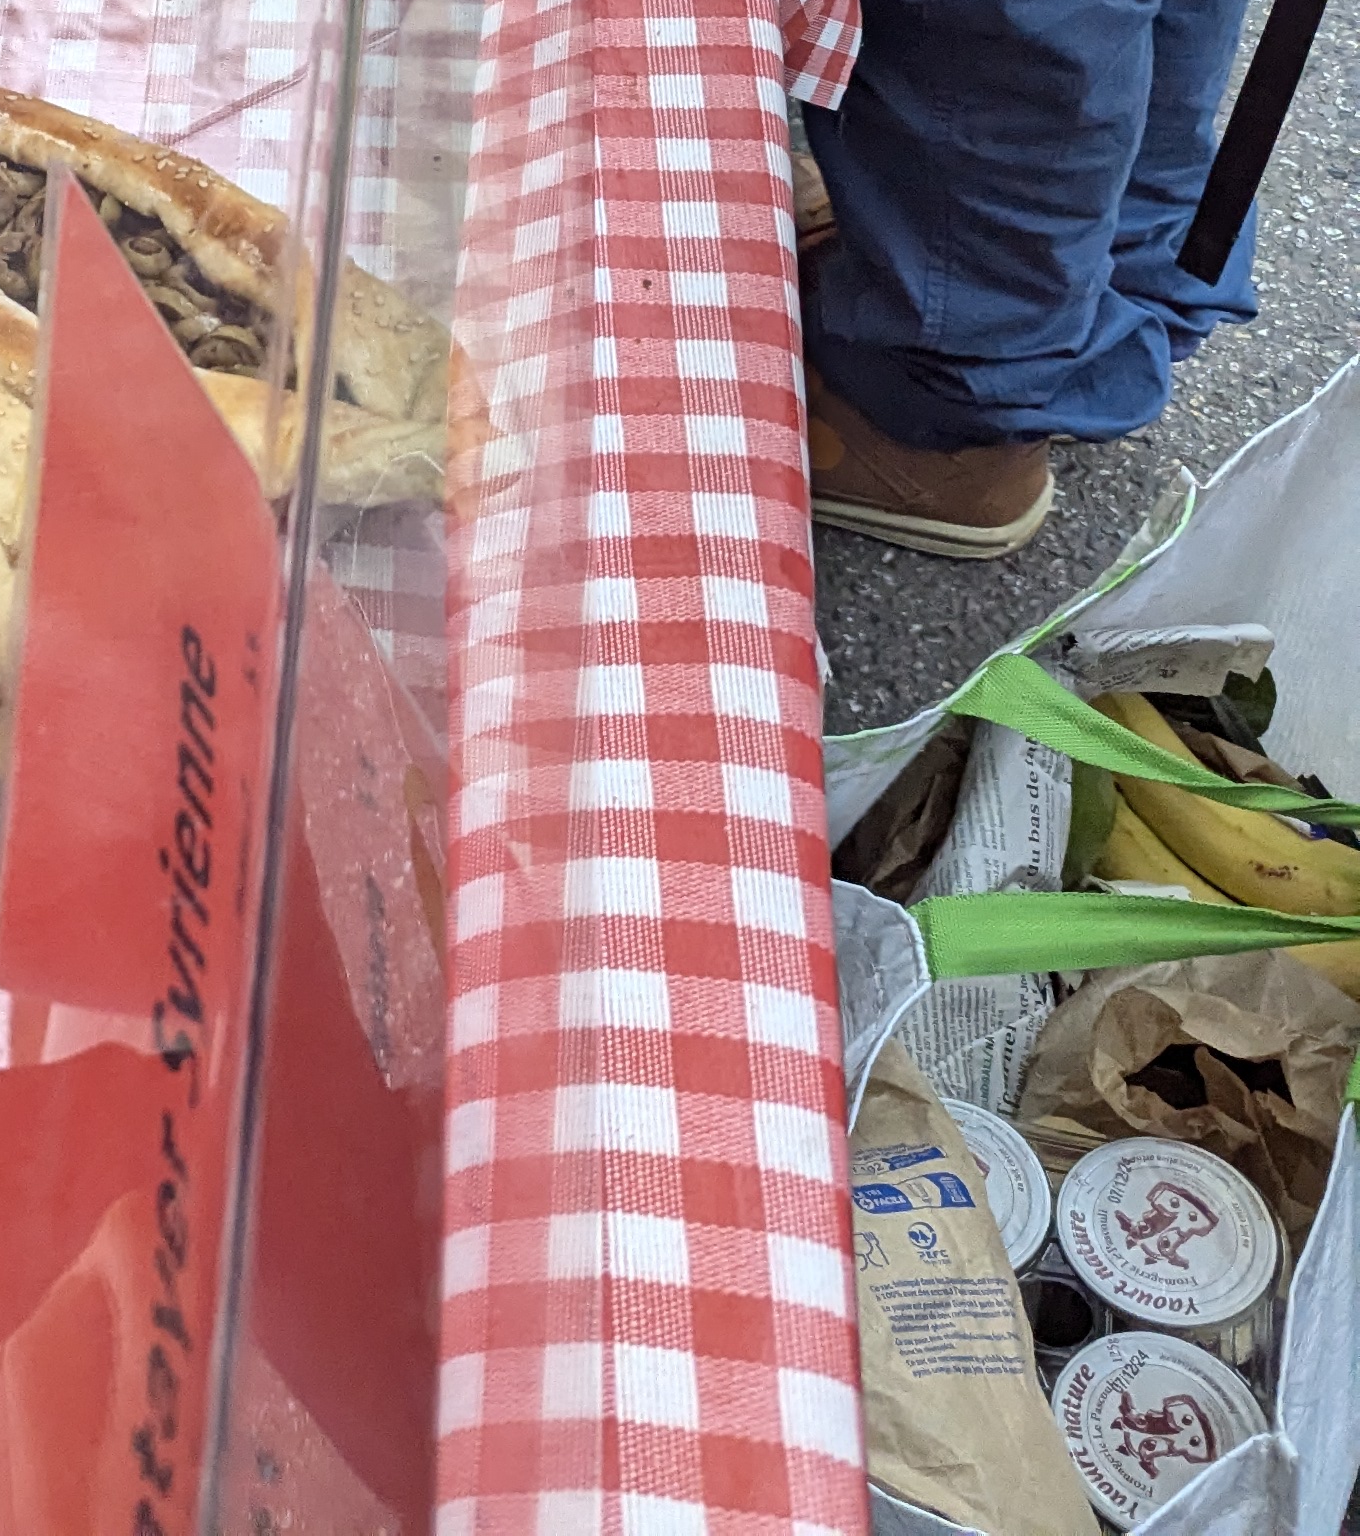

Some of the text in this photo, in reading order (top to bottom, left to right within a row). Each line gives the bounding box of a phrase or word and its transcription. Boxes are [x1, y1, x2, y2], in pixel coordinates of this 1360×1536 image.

[1026, 771, 1040, 799] de
[1028, 803, 1040, 843] bas
[1068, 1209, 1200, 1316] Yaourt nature
[1061, 1363, 1140, 1520] Yaourt nature
[1097, 1440, 1154, 1498] Fromagerie
